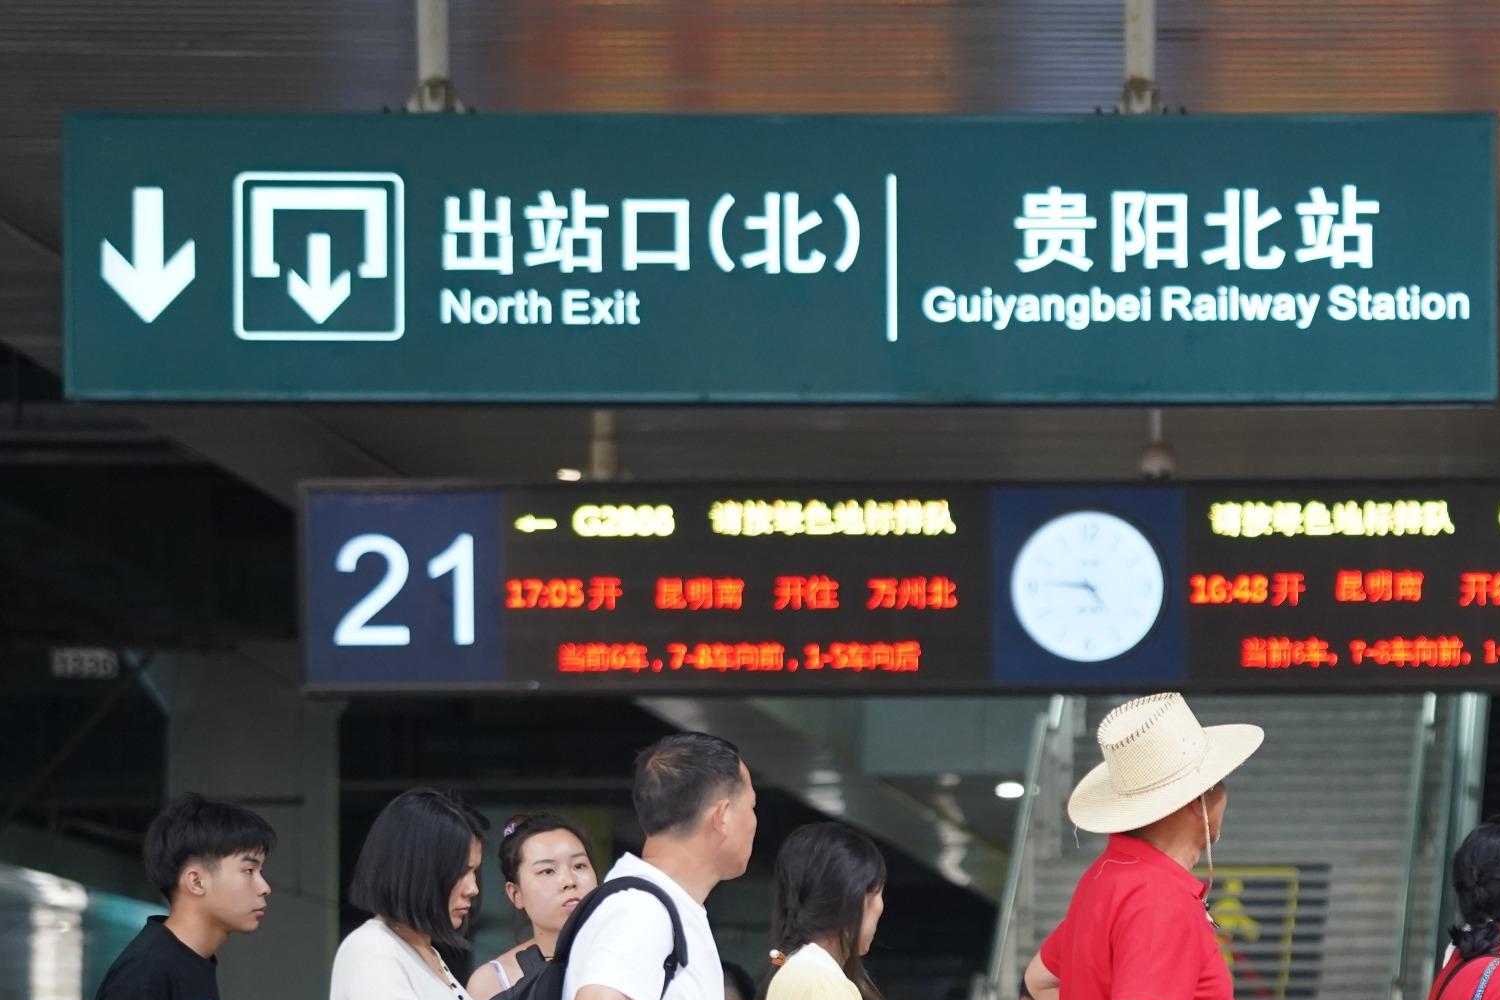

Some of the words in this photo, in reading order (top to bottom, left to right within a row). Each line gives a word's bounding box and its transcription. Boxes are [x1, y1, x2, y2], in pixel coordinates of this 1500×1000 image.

[1014, 185, 1380, 273] 贵阳北站
[441, 289, 552, 325] North
[562, 289, 641, 325] Exit
[923, 286, 1152, 331] Guiyangbei
[1161, 286, 1321, 329] Railway
[1327, 285, 1470, 321] Station
[336, 534, 475, 646] 21
[867, 575, 958, 610] 万州北
